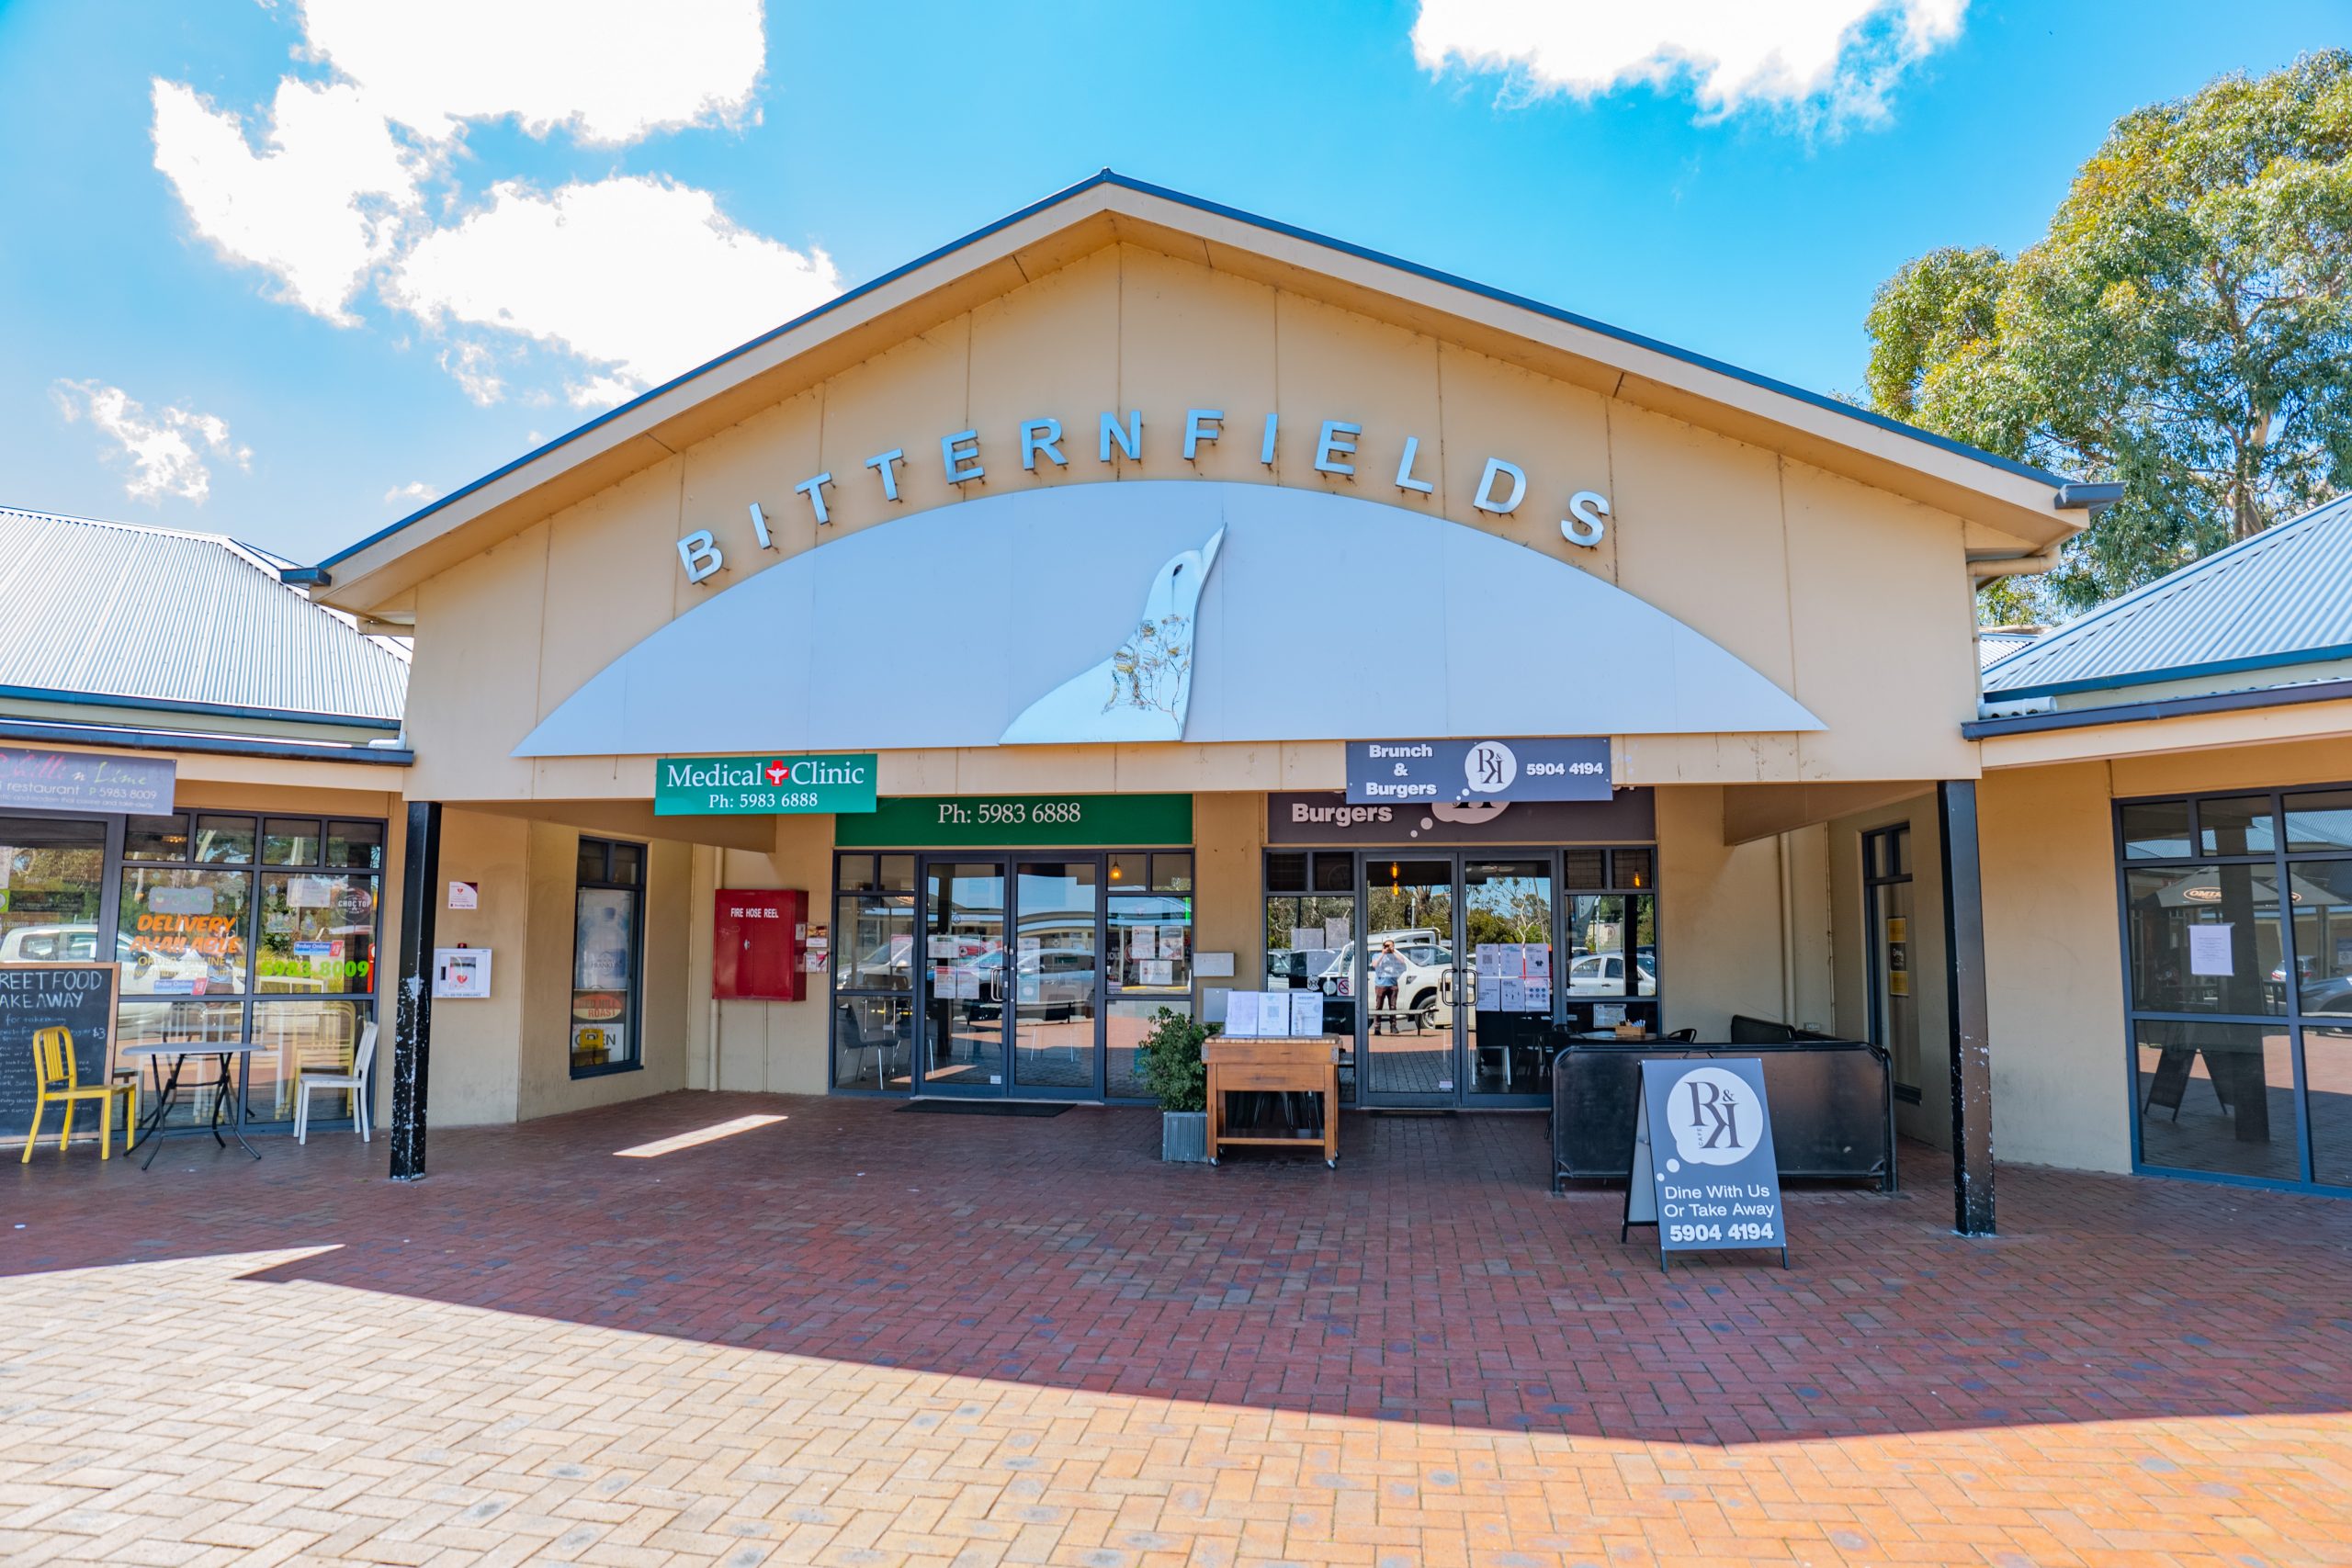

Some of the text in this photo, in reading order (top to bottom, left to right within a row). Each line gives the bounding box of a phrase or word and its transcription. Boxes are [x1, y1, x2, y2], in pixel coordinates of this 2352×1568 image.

[677, 410, 1612, 585] BITTERNFIELDS
[1369, 744, 1433, 758] Brunch
[95, 761, 147, 784] Lime
[666, 761, 865, 787] Medical Clinic
[1394, 762, 1408, 776] &
[1526, 762, 1604, 776] 5904 4194
[7, 782, 157, 800] restaurant P 5983 8009
[1365, 782, 1438, 798] Burgers
[709, 793, 818, 808] Ph: 5983 6888
[937, 803, 1081, 823] Ph: 5983 6888
[1293, 803, 1393, 827] Burgers
[730, 908, 779, 919] FIRE HOSE REEL
[137, 913, 236, 933] DELIVERY
[130, 934, 242, 954] AVAILABLE
[138, 955, 226, 967] ORDER ONLINE
[261, 960, 369, 978] 5983 8009
[0, 971, 102, 990] REET FOOD
[0, 992, 84, 1009] AKEAWAY
[93, 1027, 106, 1040] $3
[574, 1033, 616, 1046] OPN
[1665, 1184, 1770, 1200] Dine With Us
[1664, 1203, 1774, 1218] Or Take Away
[1669, 1223, 1774, 1241] 5904 4194
